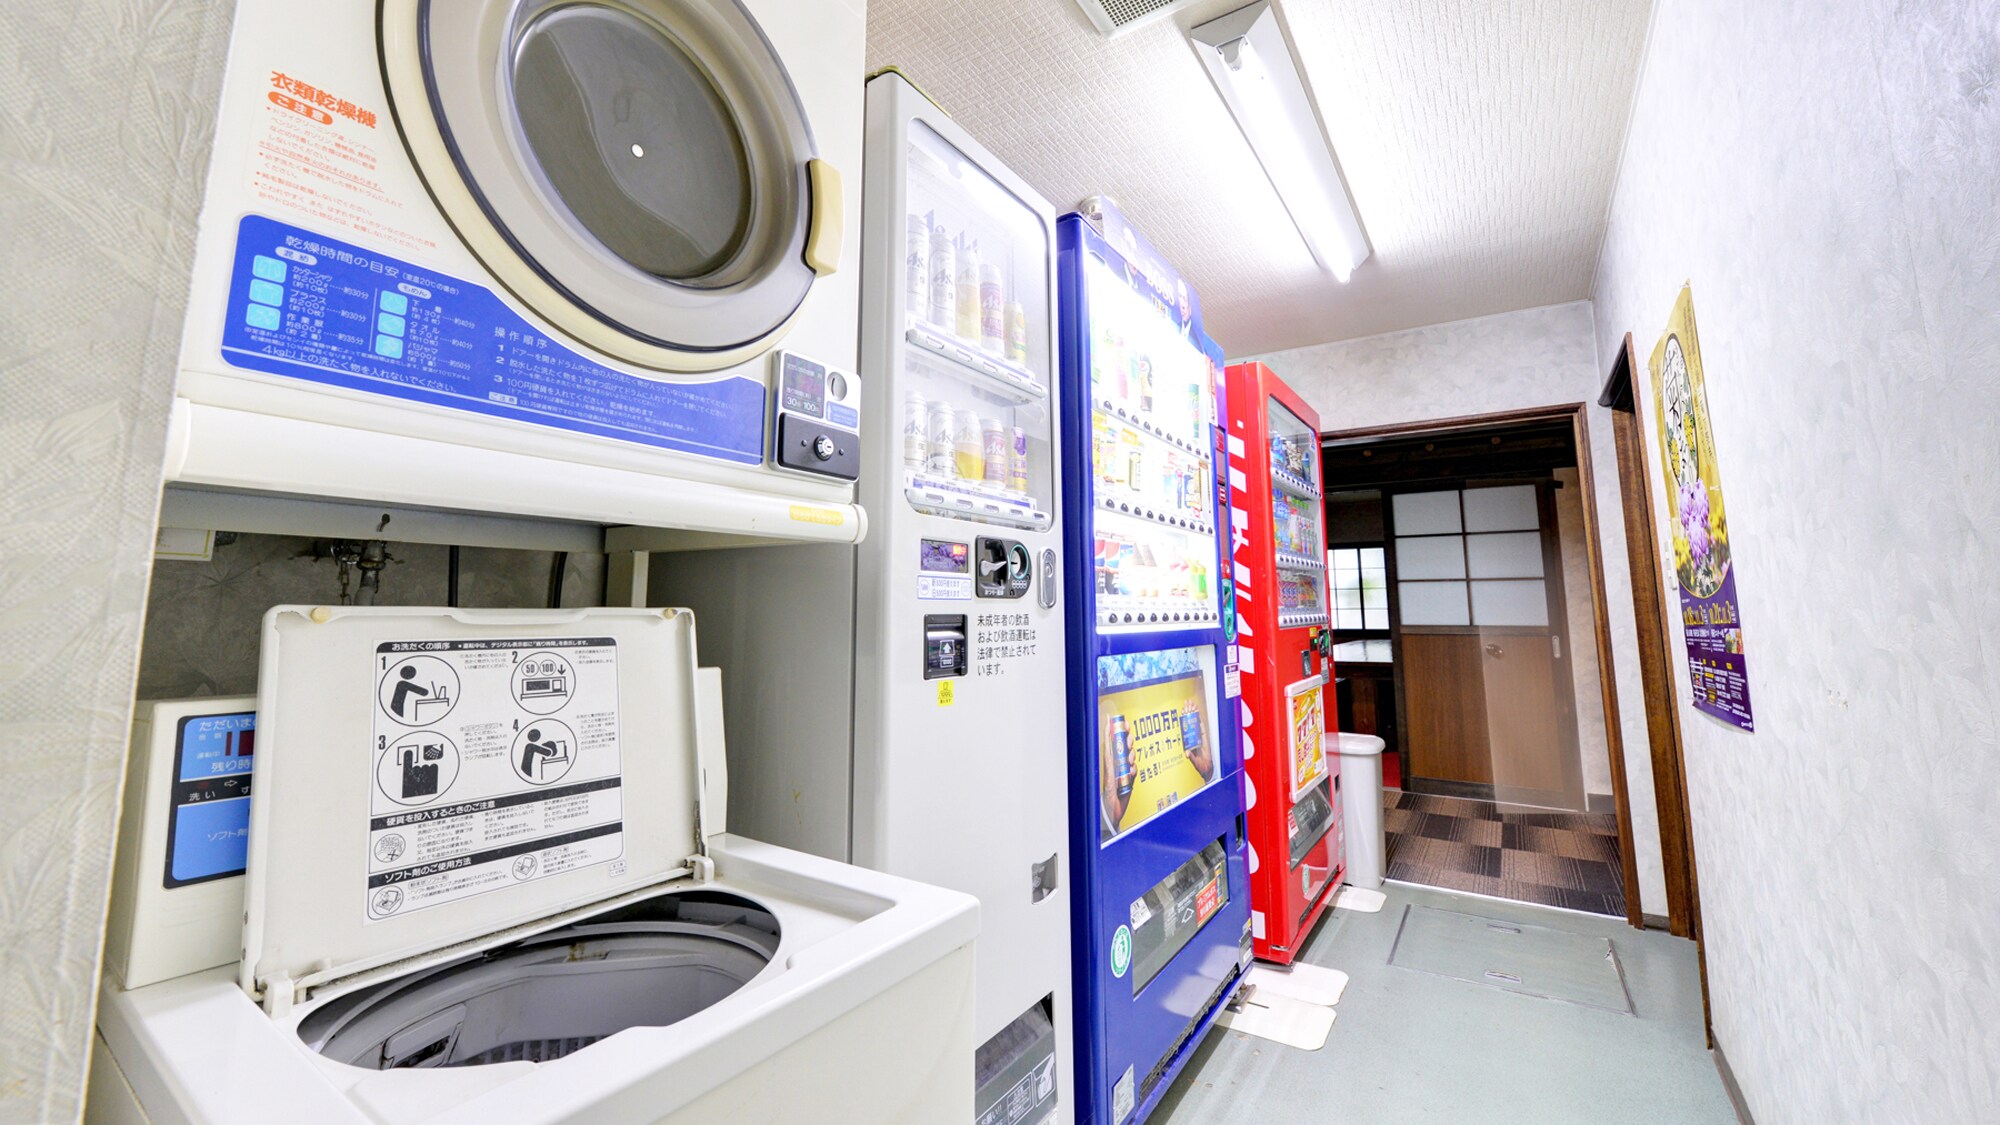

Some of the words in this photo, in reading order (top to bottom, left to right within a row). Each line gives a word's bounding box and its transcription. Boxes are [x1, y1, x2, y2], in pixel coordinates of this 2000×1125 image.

[271, 71, 377, 129] 衣類乾燥機
[277, 94, 325, 120] ご注意
[285, 235, 399, 279] 乾燥時間の目安
[343, 286, 369, 300] 約30分
[341, 309, 367, 322] 約30分
[494, 326, 548, 349] 操作順序
[497, 344, 504, 352] 1
[495, 356, 505, 365] 2
[494, 374, 503, 383] 3
[977, 613, 1030, 626] 未成年者の飲酒
[977, 628, 1037, 643] および飲酒運転は
[512, 651, 519, 663] 2
[977, 644, 1037, 660] 法律で禁止されて
[381, 656, 386, 670] 1
[526, 664, 535, 674] 50
[542, 663, 553, 673] 100
[977, 662, 1005, 676] います。
[199, 720, 256, 732] ただいま
[513, 719, 519, 732] 4
[379, 735, 386, 750] 3
[386, 800, 496, 826] 硬貨を投入するときのご注意
[385, 857, 472, 884] ソフト剤のご使用方法
